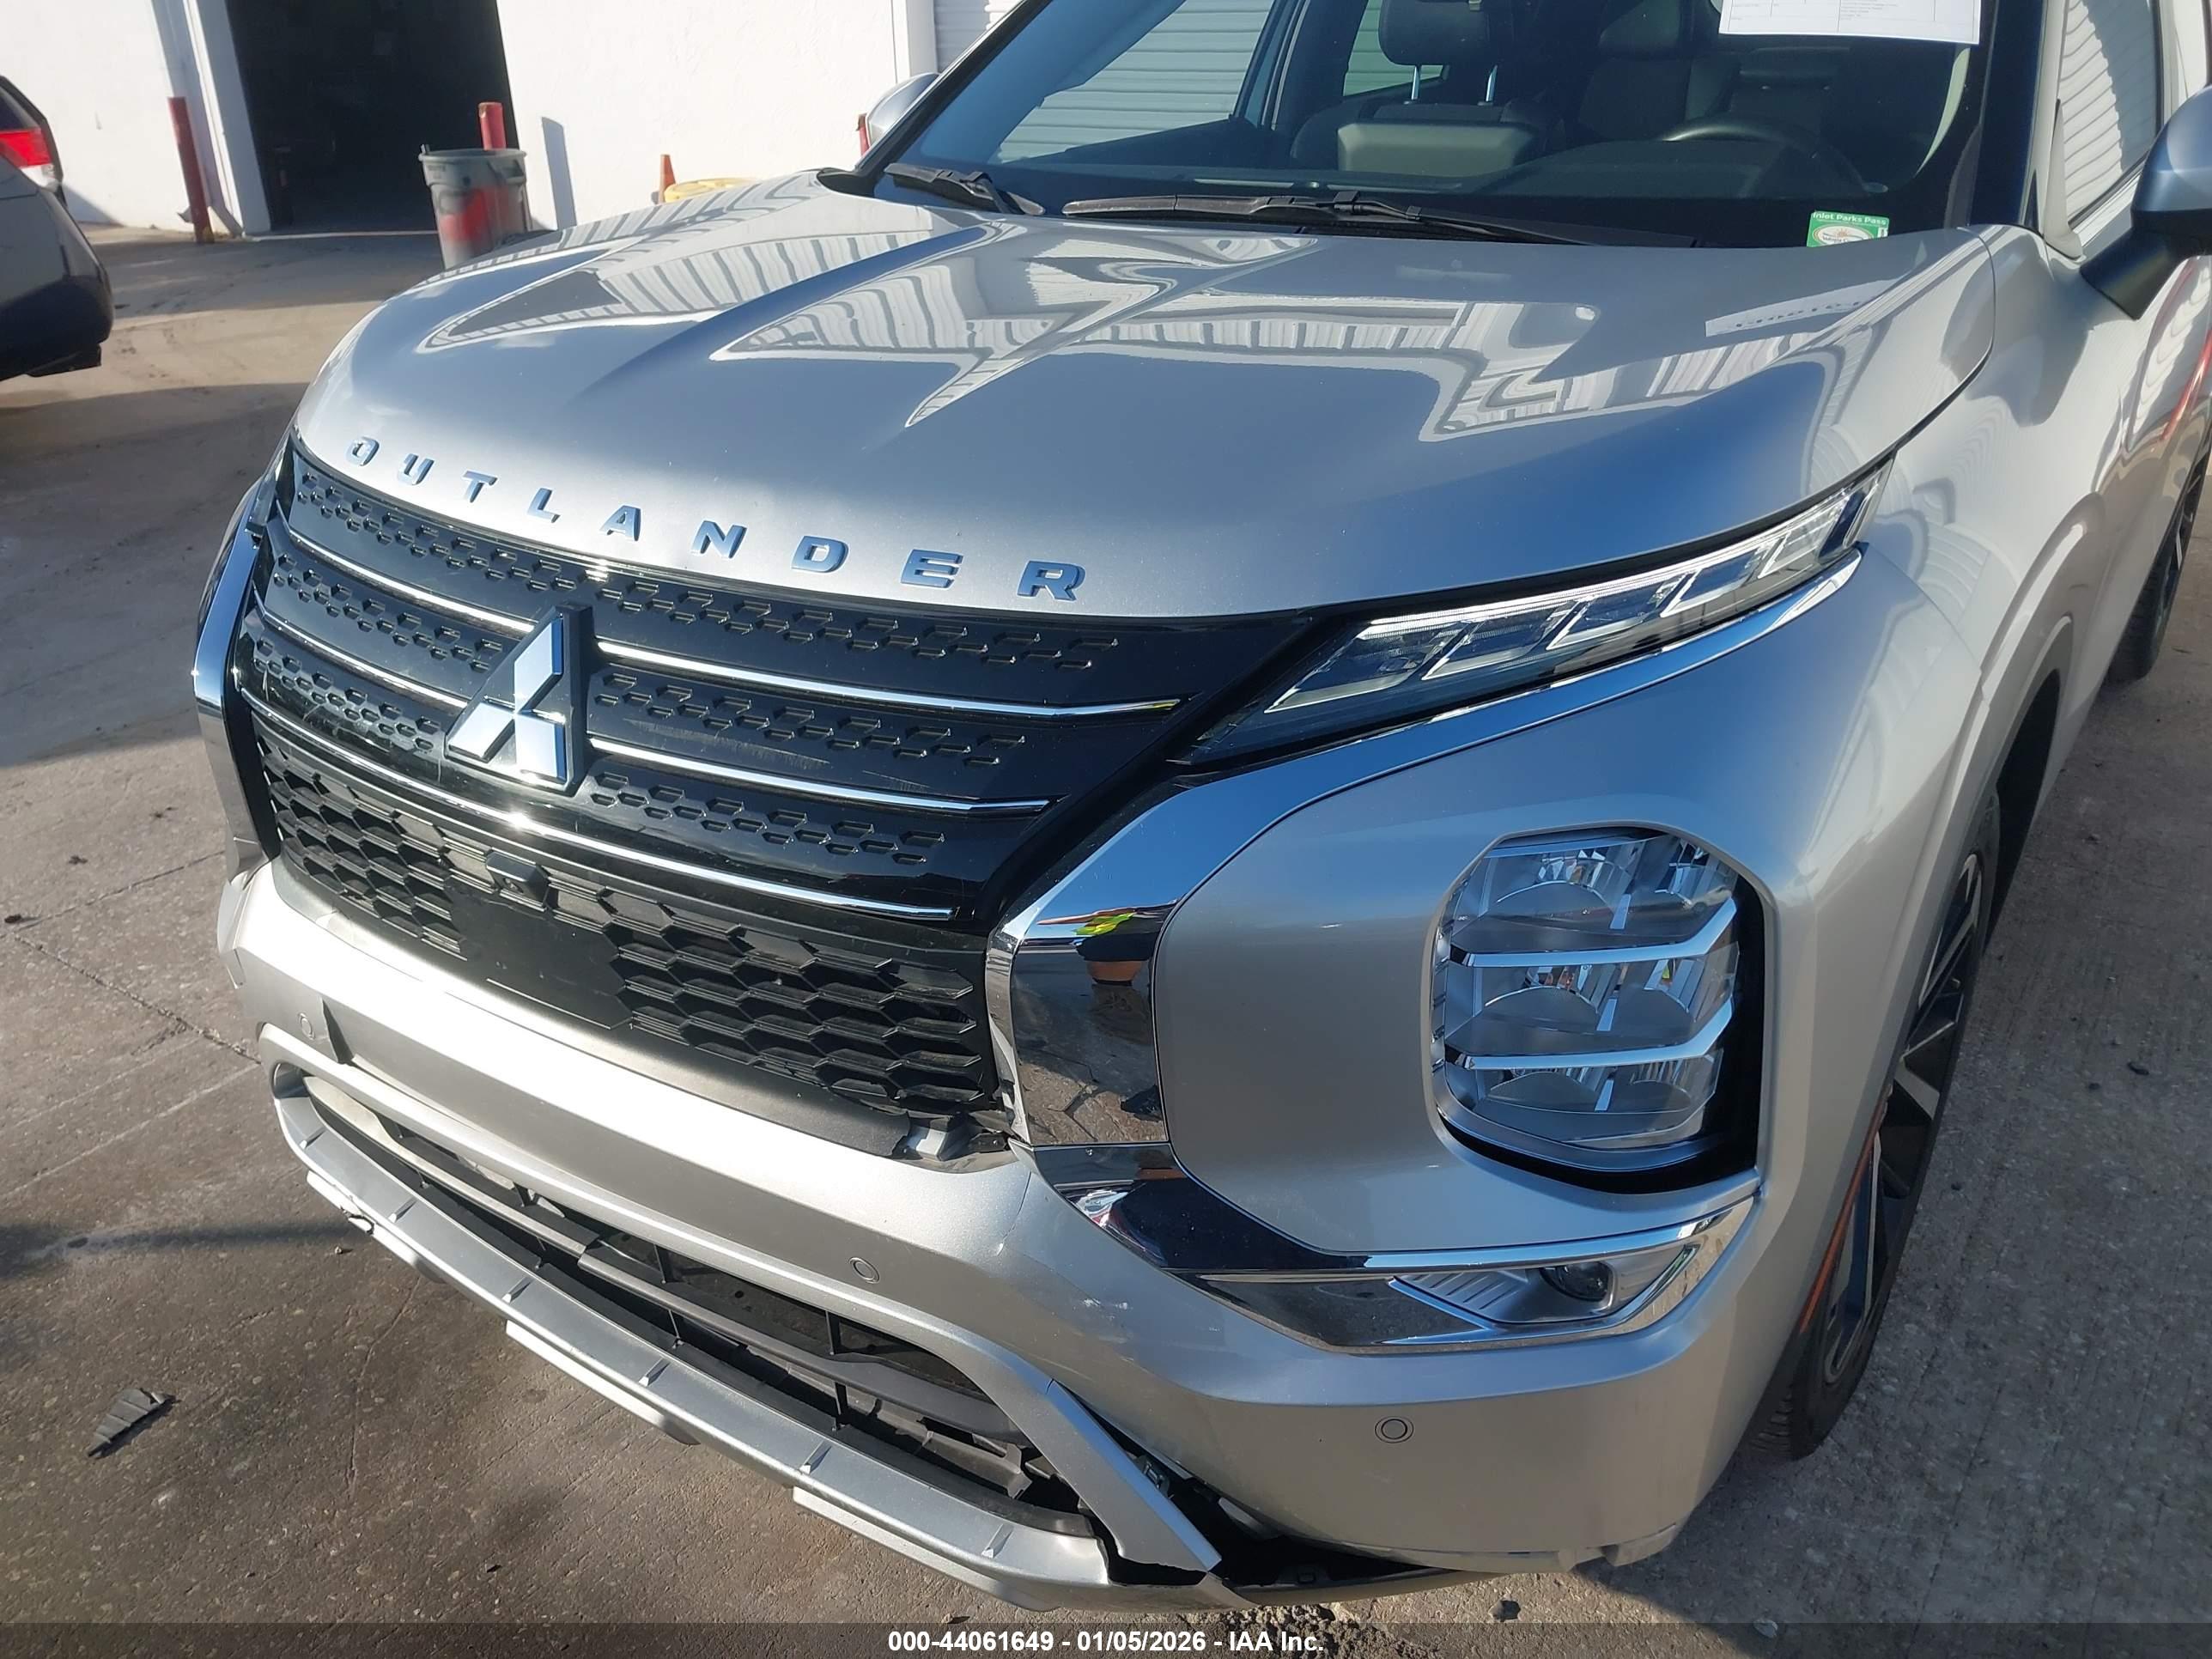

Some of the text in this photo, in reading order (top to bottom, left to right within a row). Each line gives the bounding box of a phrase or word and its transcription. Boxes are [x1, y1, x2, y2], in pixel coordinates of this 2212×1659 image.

[1837, 214, 1863, 222] Parks
[1864, 216, 1887, 225] Pass
[345, 434, 1085, 602] OUTLANDER
